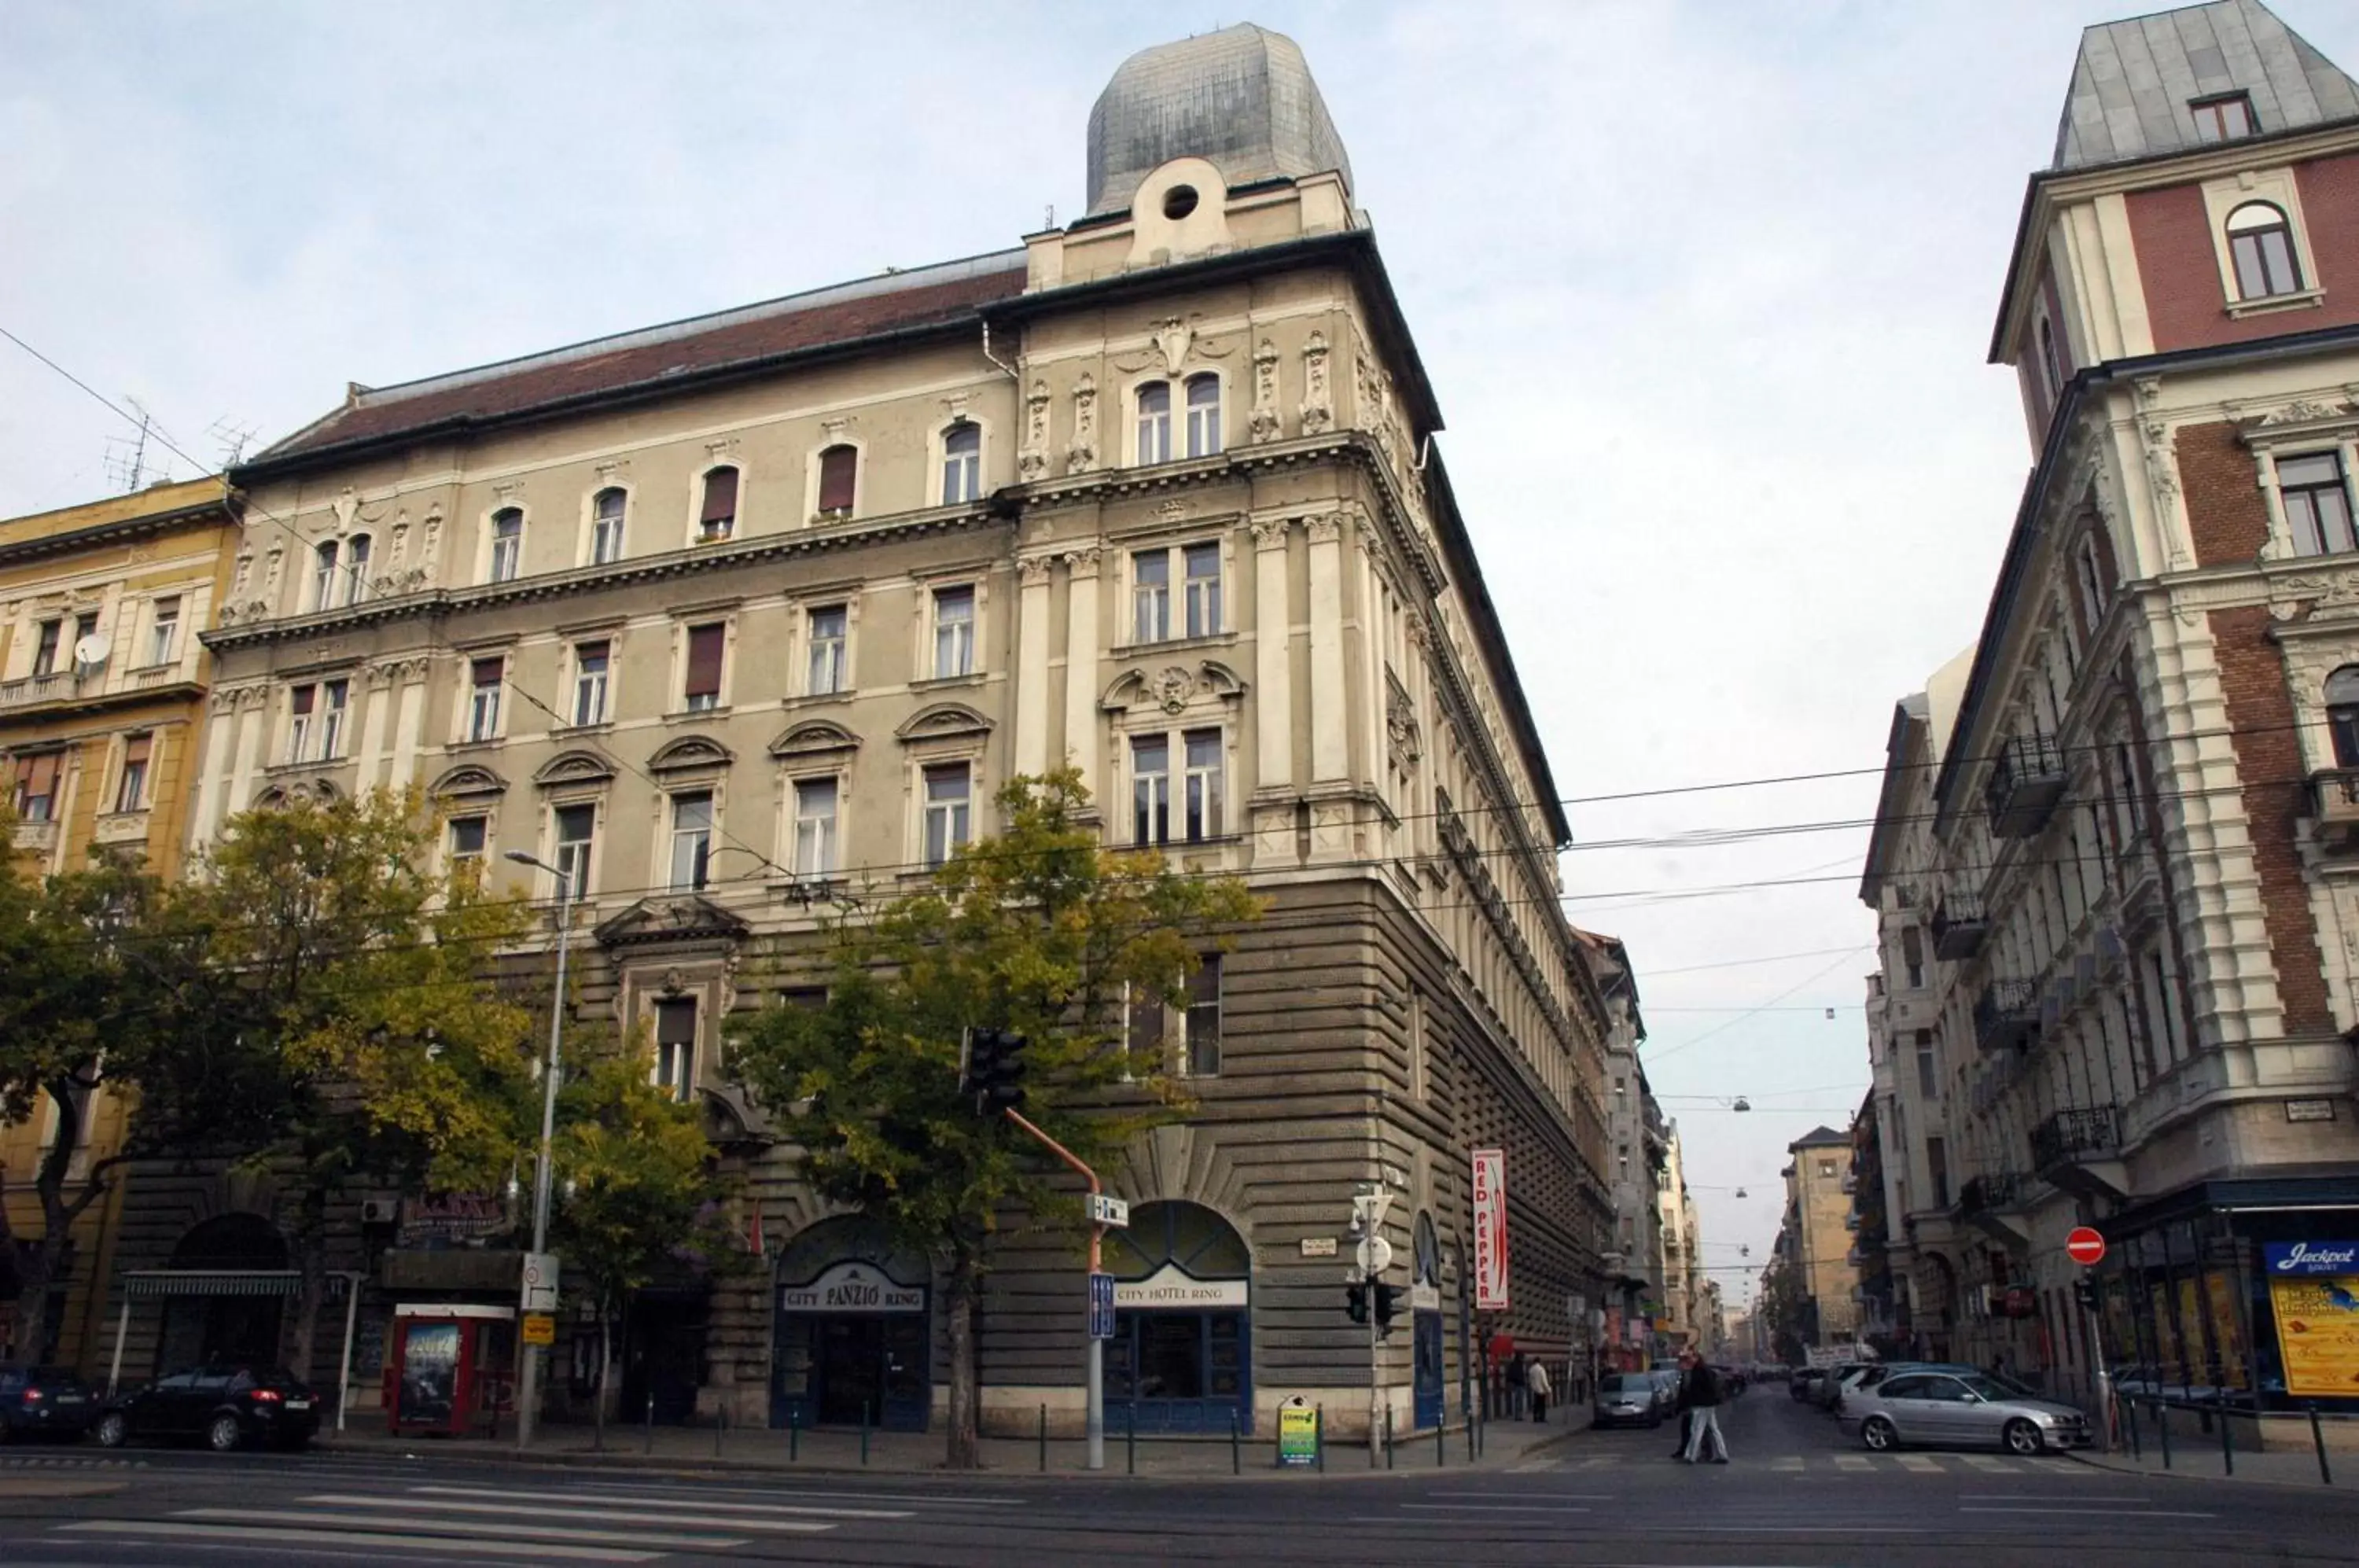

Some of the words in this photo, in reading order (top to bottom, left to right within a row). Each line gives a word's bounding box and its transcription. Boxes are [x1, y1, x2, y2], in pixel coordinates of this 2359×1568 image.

[1476, 1161, 1488, 1202] RED
[1478, 1212, 1489, 1298] PEPPER
[2277, 1242, 2354, 1270] Jackpot
[787, 1292, 819, 1306] CITY
[885, 1292, 919, 1306] RING
[1117, 1290, 1144, 1300] CITY
[1149, 1287, 1187, 1301] HOTEL
[1191, 1288, 1224, 1299] RING
